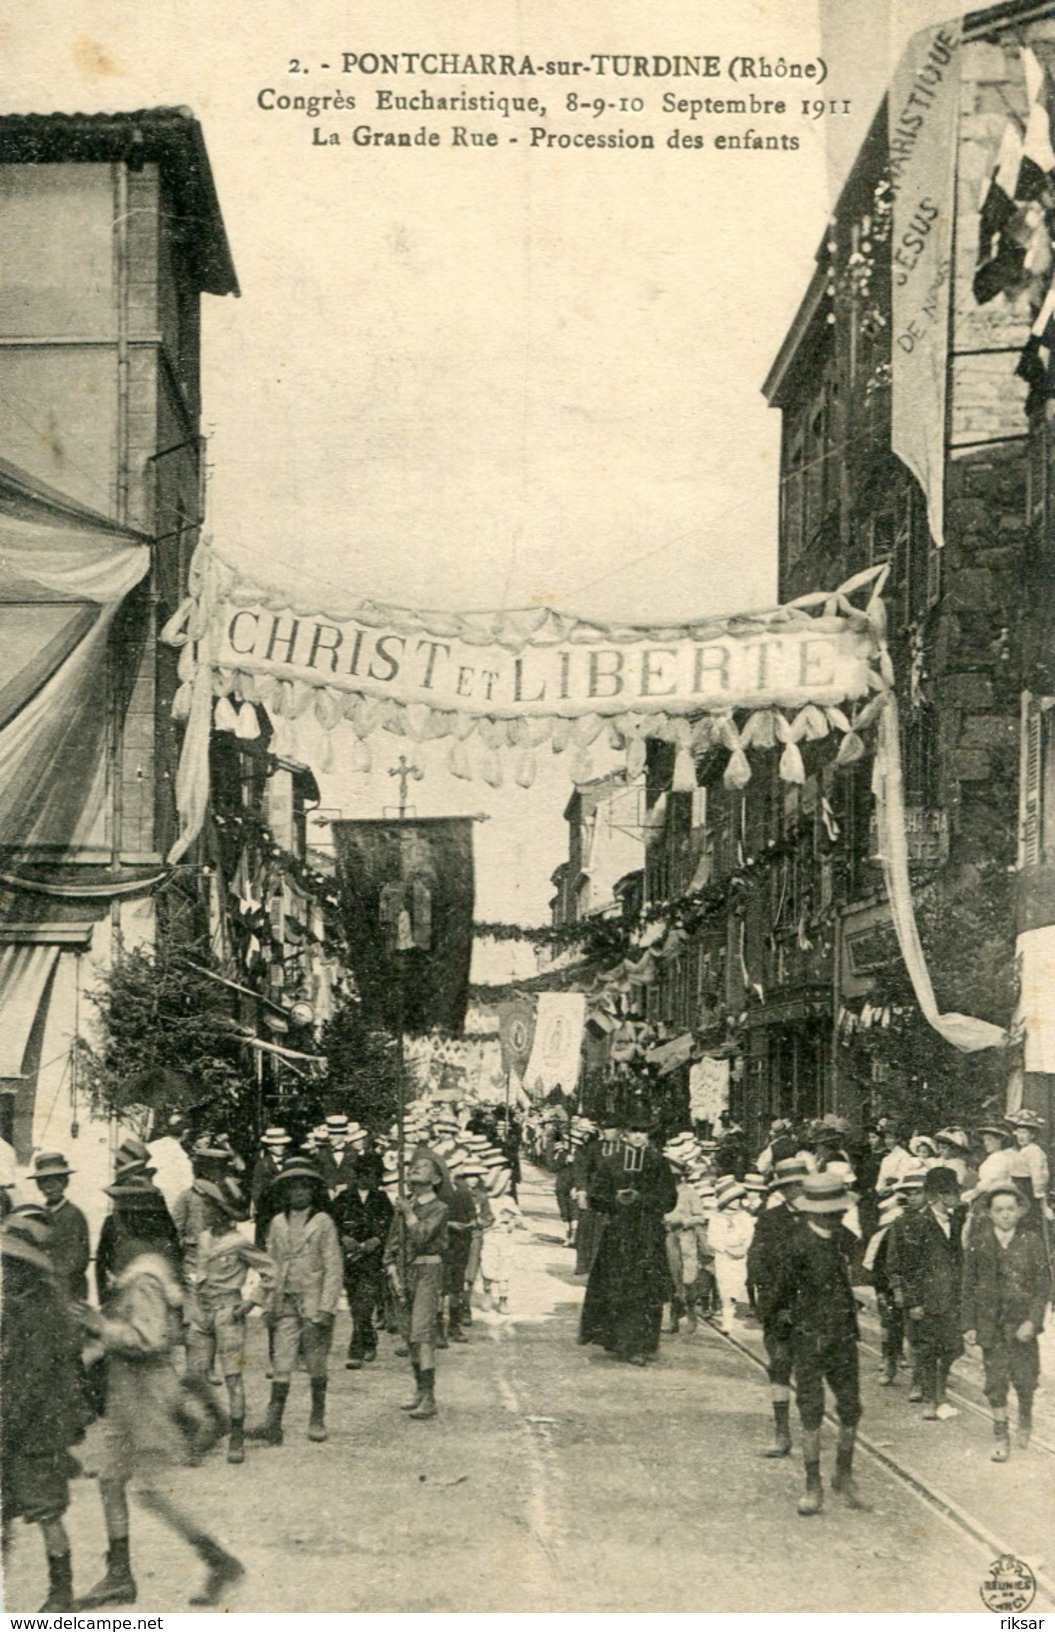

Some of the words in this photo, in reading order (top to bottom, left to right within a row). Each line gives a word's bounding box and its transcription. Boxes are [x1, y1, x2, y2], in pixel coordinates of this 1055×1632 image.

[227, 610, 451, 690] CHRIST
[456, 665, 499, 701] ET
[512, 639, 836, 703] LIBERTE
